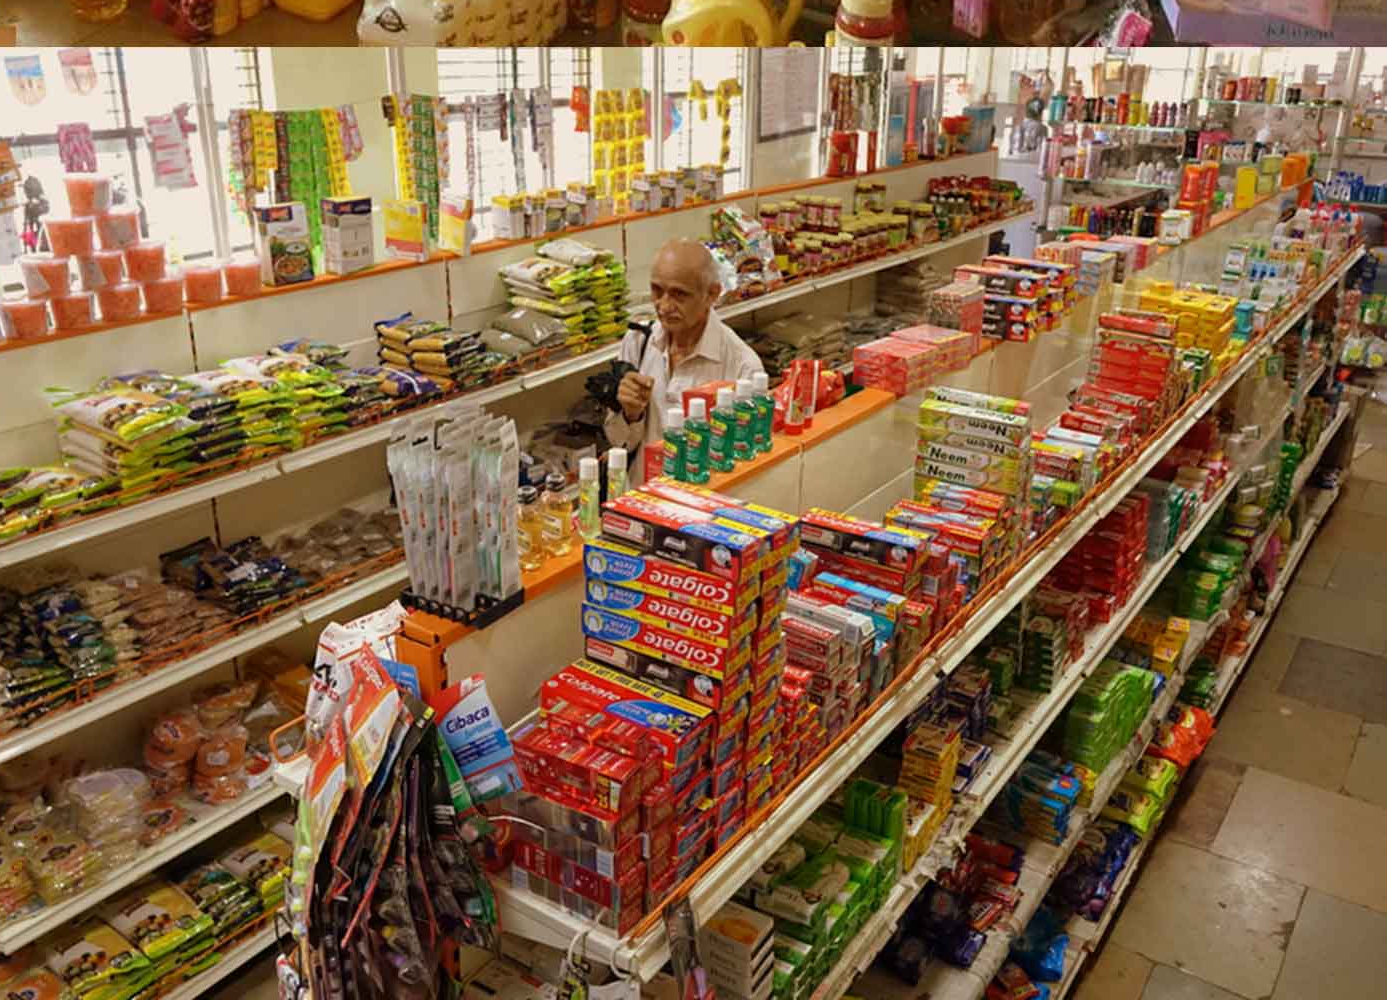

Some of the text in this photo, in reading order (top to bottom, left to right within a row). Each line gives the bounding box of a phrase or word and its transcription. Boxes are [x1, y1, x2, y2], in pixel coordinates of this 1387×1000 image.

[968, 418, 1008, 437] Neem
[929, 446, 968, 465] Neem
[965, 437, 1006, 455] Neem
[926, 464, 967, 481] Neem
[648, 569, 731, 605] Colgate
[647, 598, 726, 636] Colgate
[643, 630, 721, 668] Colgate
[558, 671, 622, 701] Colgate
[445, 705, 490, 735] Cibaca
